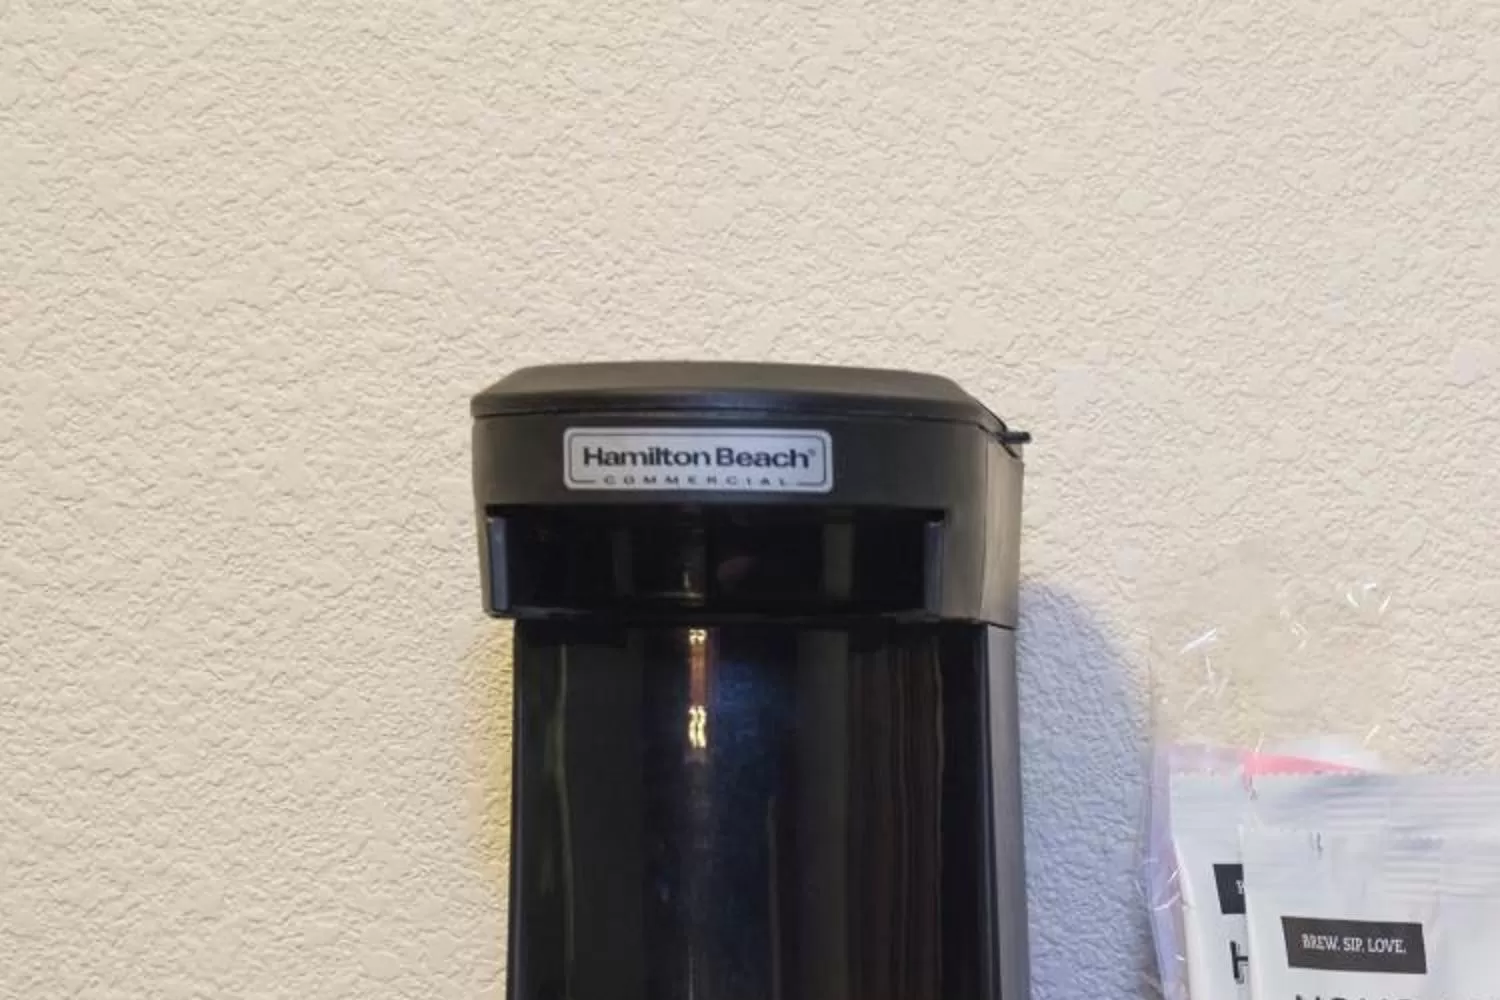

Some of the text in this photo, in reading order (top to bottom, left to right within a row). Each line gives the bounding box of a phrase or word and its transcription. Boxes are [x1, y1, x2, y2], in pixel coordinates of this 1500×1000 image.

[583, 446, 711, 468] Hamilton
[603, 475, 787, 487] COMMERCIAL
[1301, 932, 1407, 955] BREW. SIP. LOVE.
